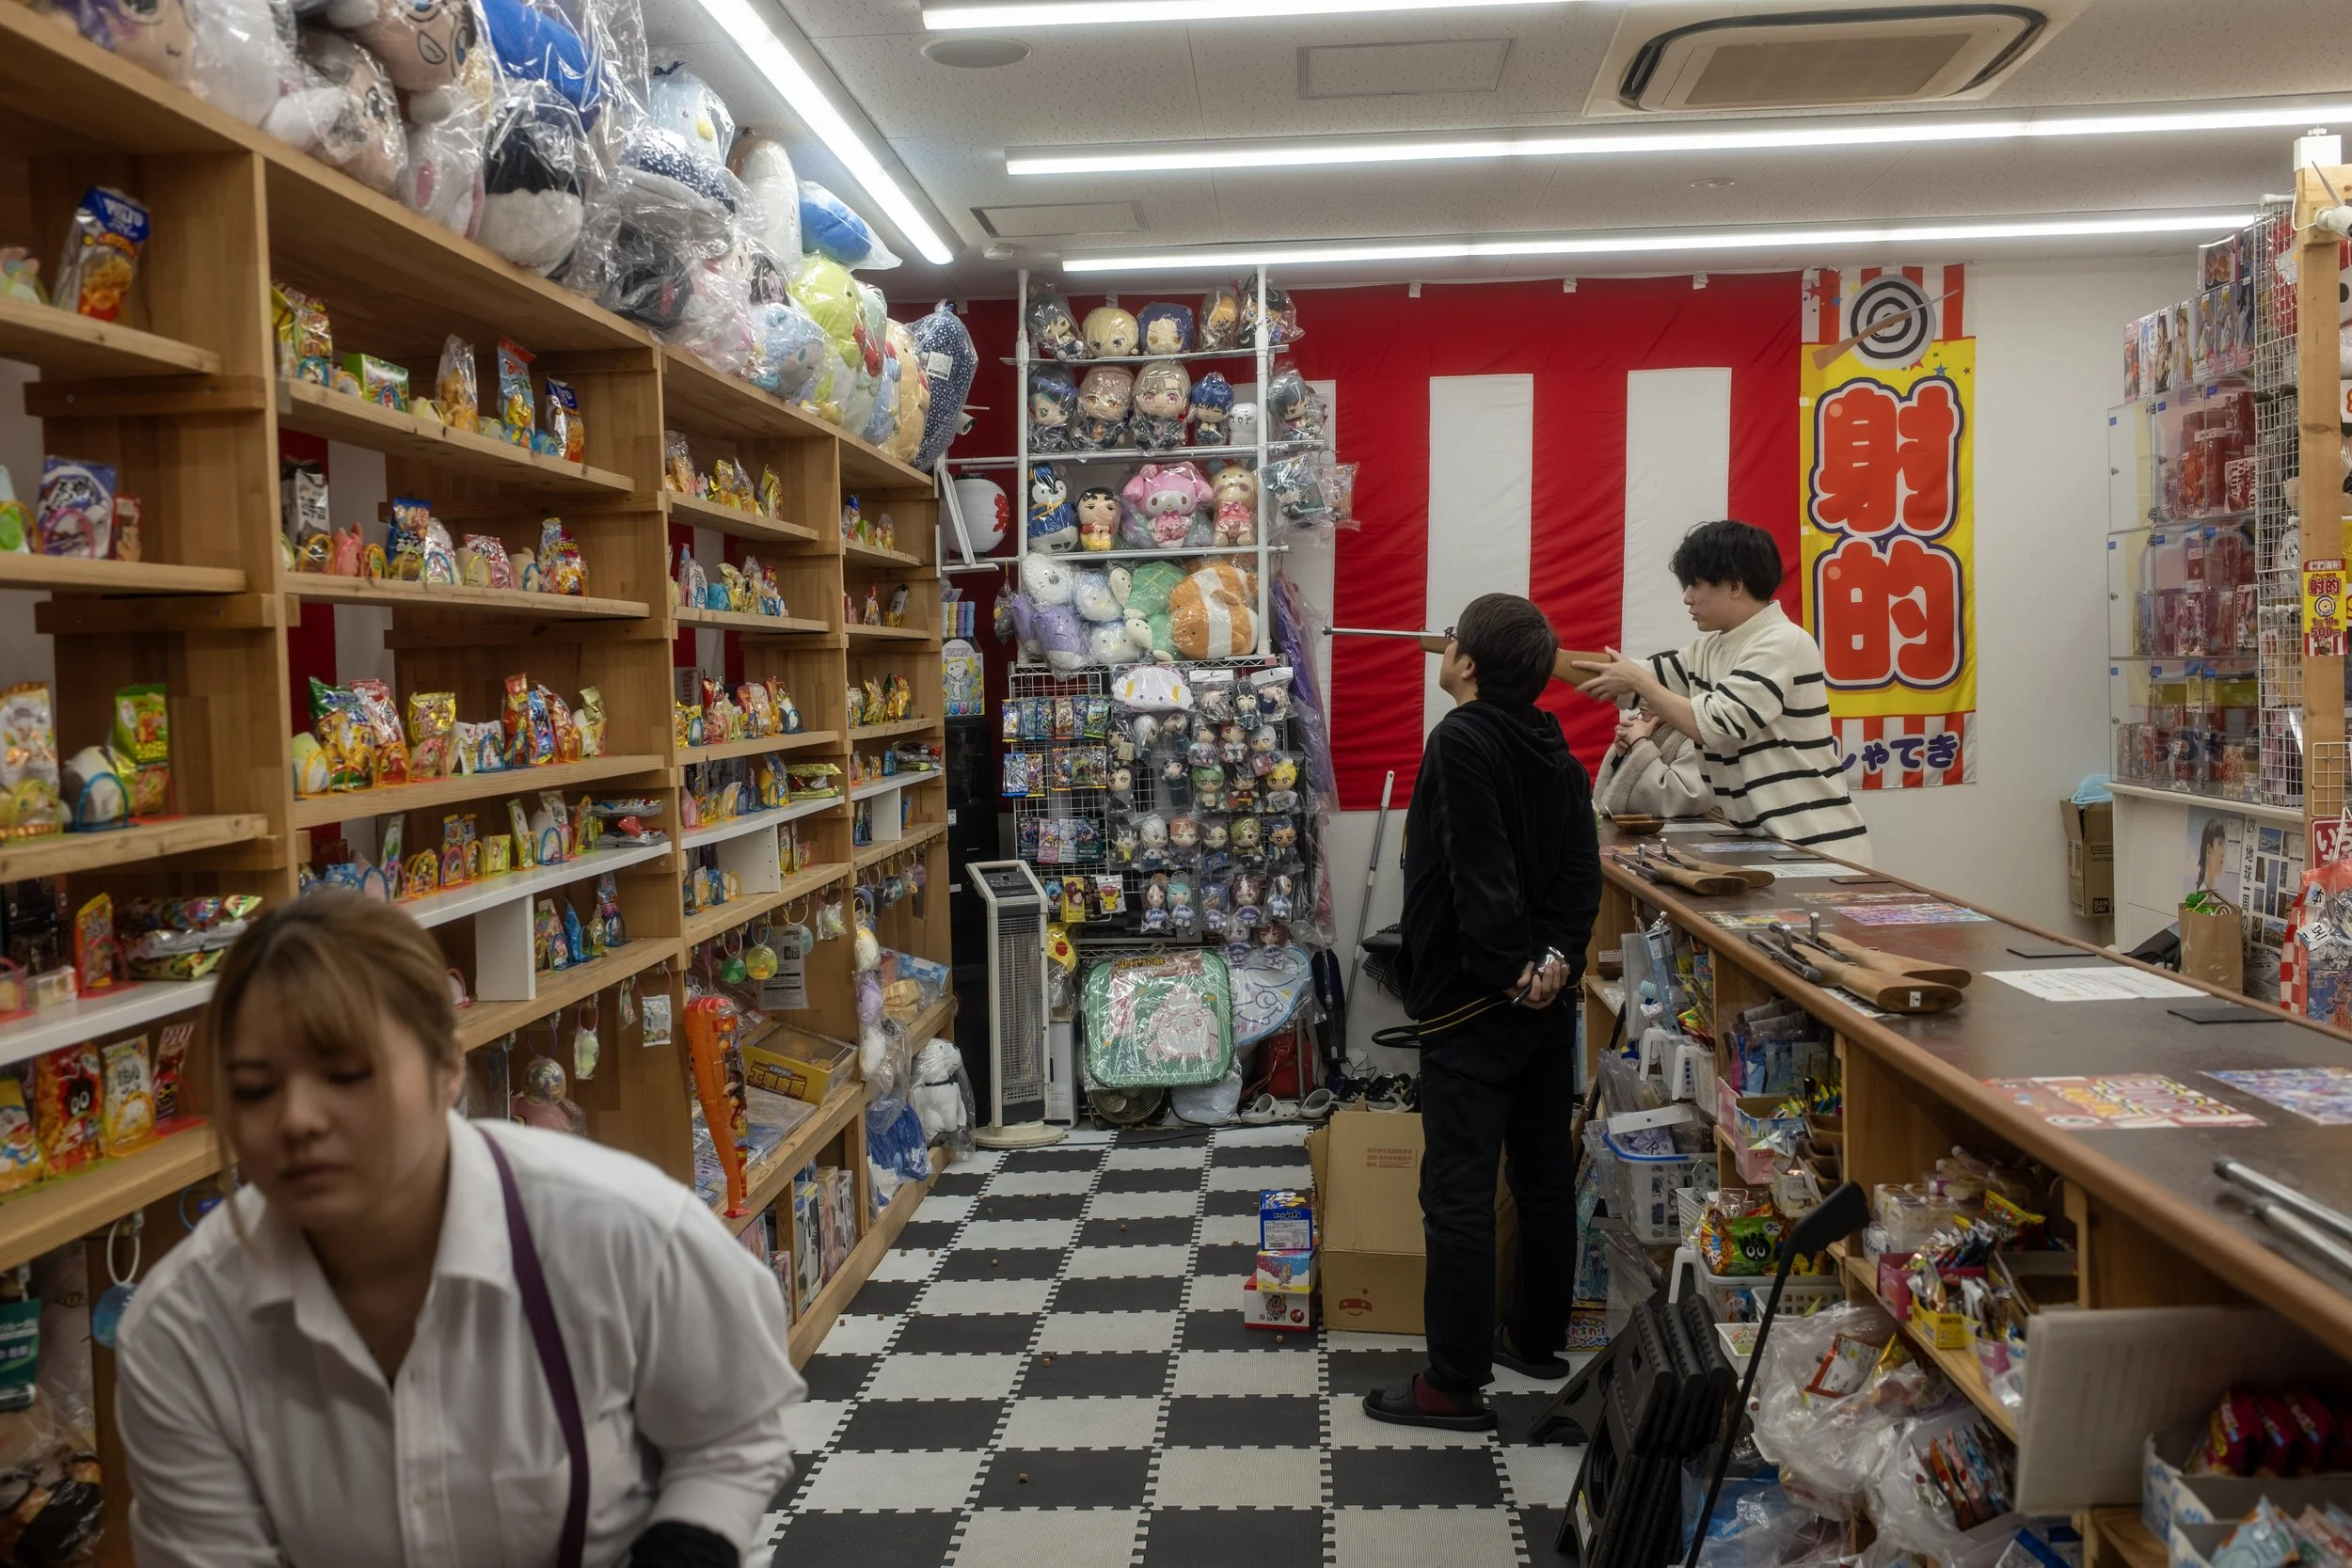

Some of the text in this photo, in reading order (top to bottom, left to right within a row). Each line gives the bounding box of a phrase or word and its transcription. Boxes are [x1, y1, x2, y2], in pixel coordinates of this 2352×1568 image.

[1811, 380, 1961, 688] 射的
[2309, 578, 2341, 595] 射的
[2241, 844, 2254, 963] 地球一周の
